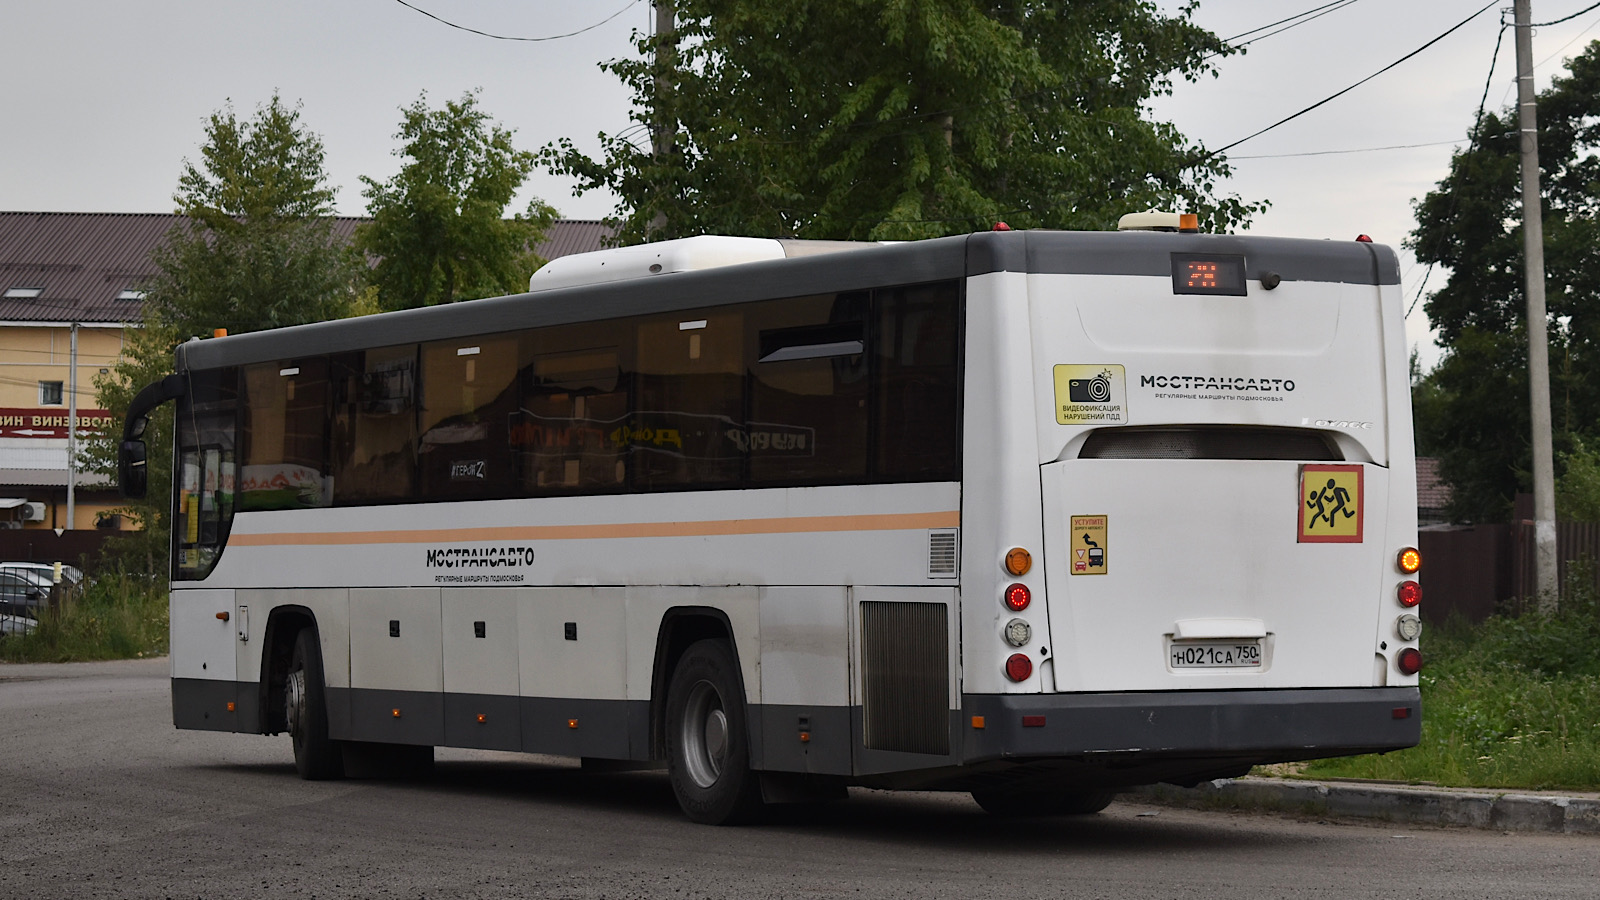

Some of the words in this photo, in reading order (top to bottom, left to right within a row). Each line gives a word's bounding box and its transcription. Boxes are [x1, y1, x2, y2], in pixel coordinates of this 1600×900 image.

[1140, 374, 1296, 392] МОСТРАНСАВТО
[1062, 404, 1121, 412] ВИДЕОФИКСАЦИЯ
[1063, 412, 1105, 420] НАРУШЕНИЙ
[1105, 413, 1121, 421] ПДД
[1074, 518, 1104, 526] УСТУПИТЕ
[426, 547, 535, 568] МОСТРАНСАВТО
[435, 575, 463, 583] РЕГУЛЯРНЫЕ
[490, 574, 524, 582] ПОДМОСКОВЬЯ
[1235, 646, 1257, 659] 750
